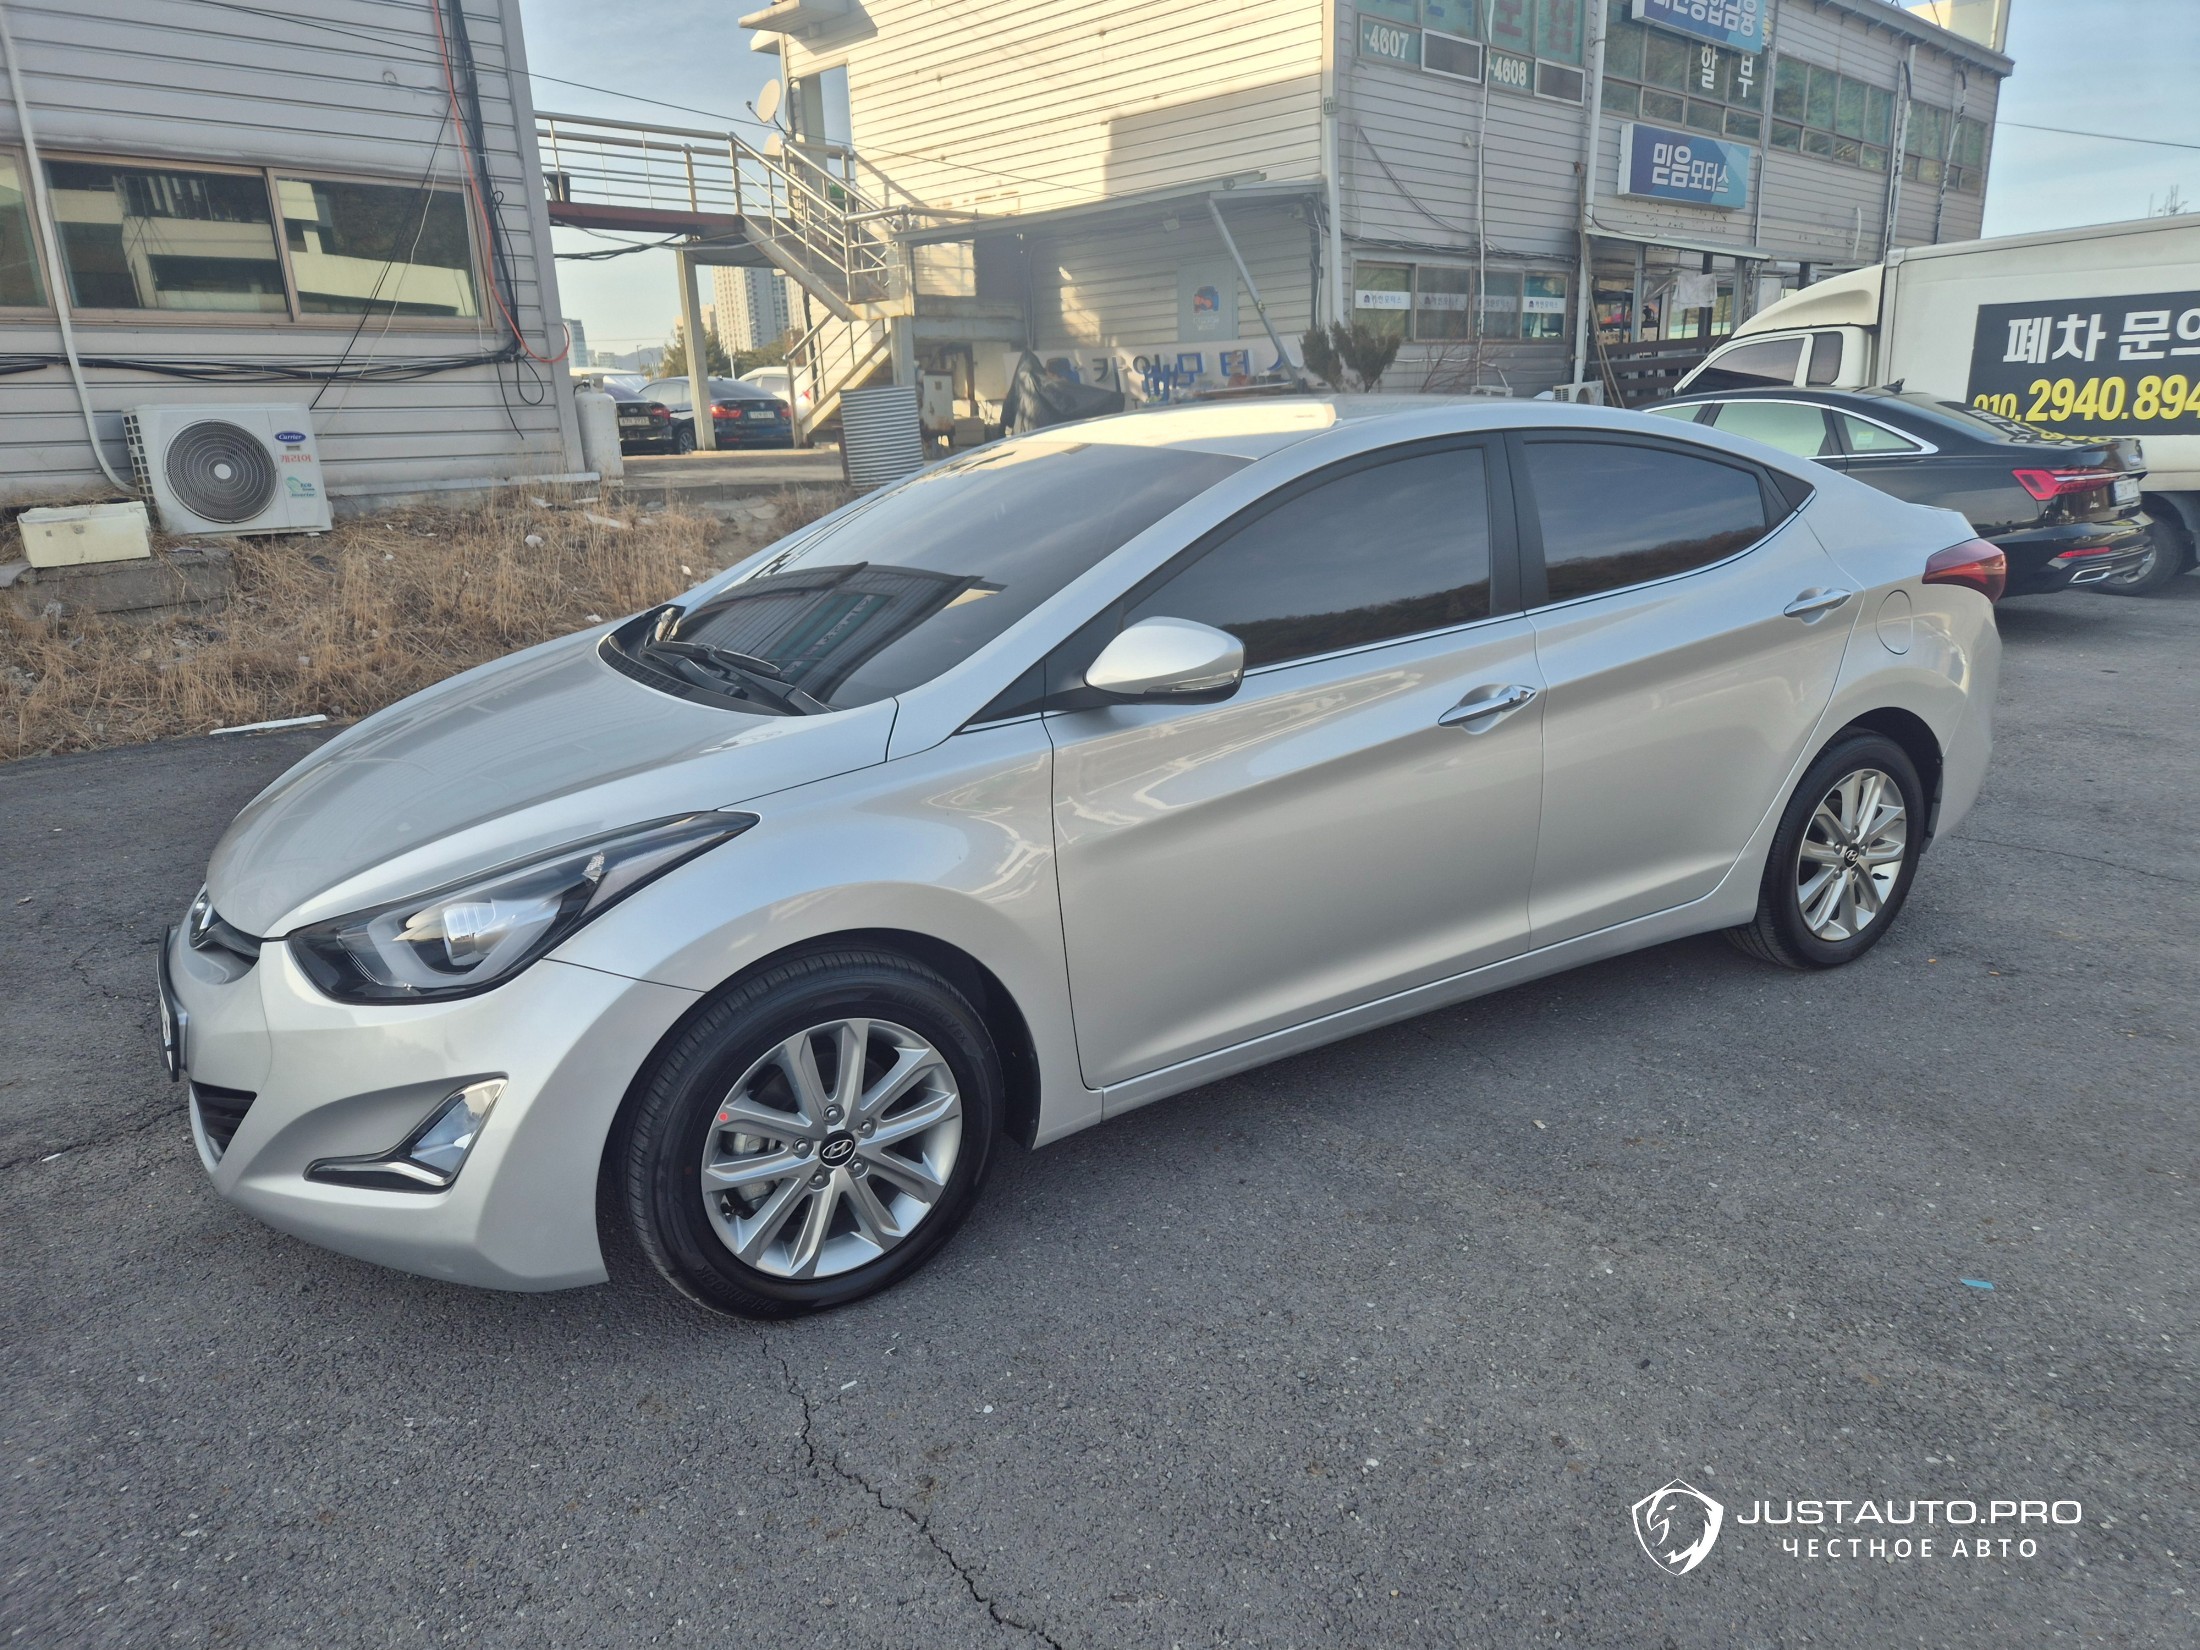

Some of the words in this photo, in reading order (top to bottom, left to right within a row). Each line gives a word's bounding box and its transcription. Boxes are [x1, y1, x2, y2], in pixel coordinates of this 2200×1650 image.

[1653, 0, 1757, 37] 합금융
[1652, 143, 1728, 193] 믿음모터스
[2003, 314, 2106, 363] 폐차
